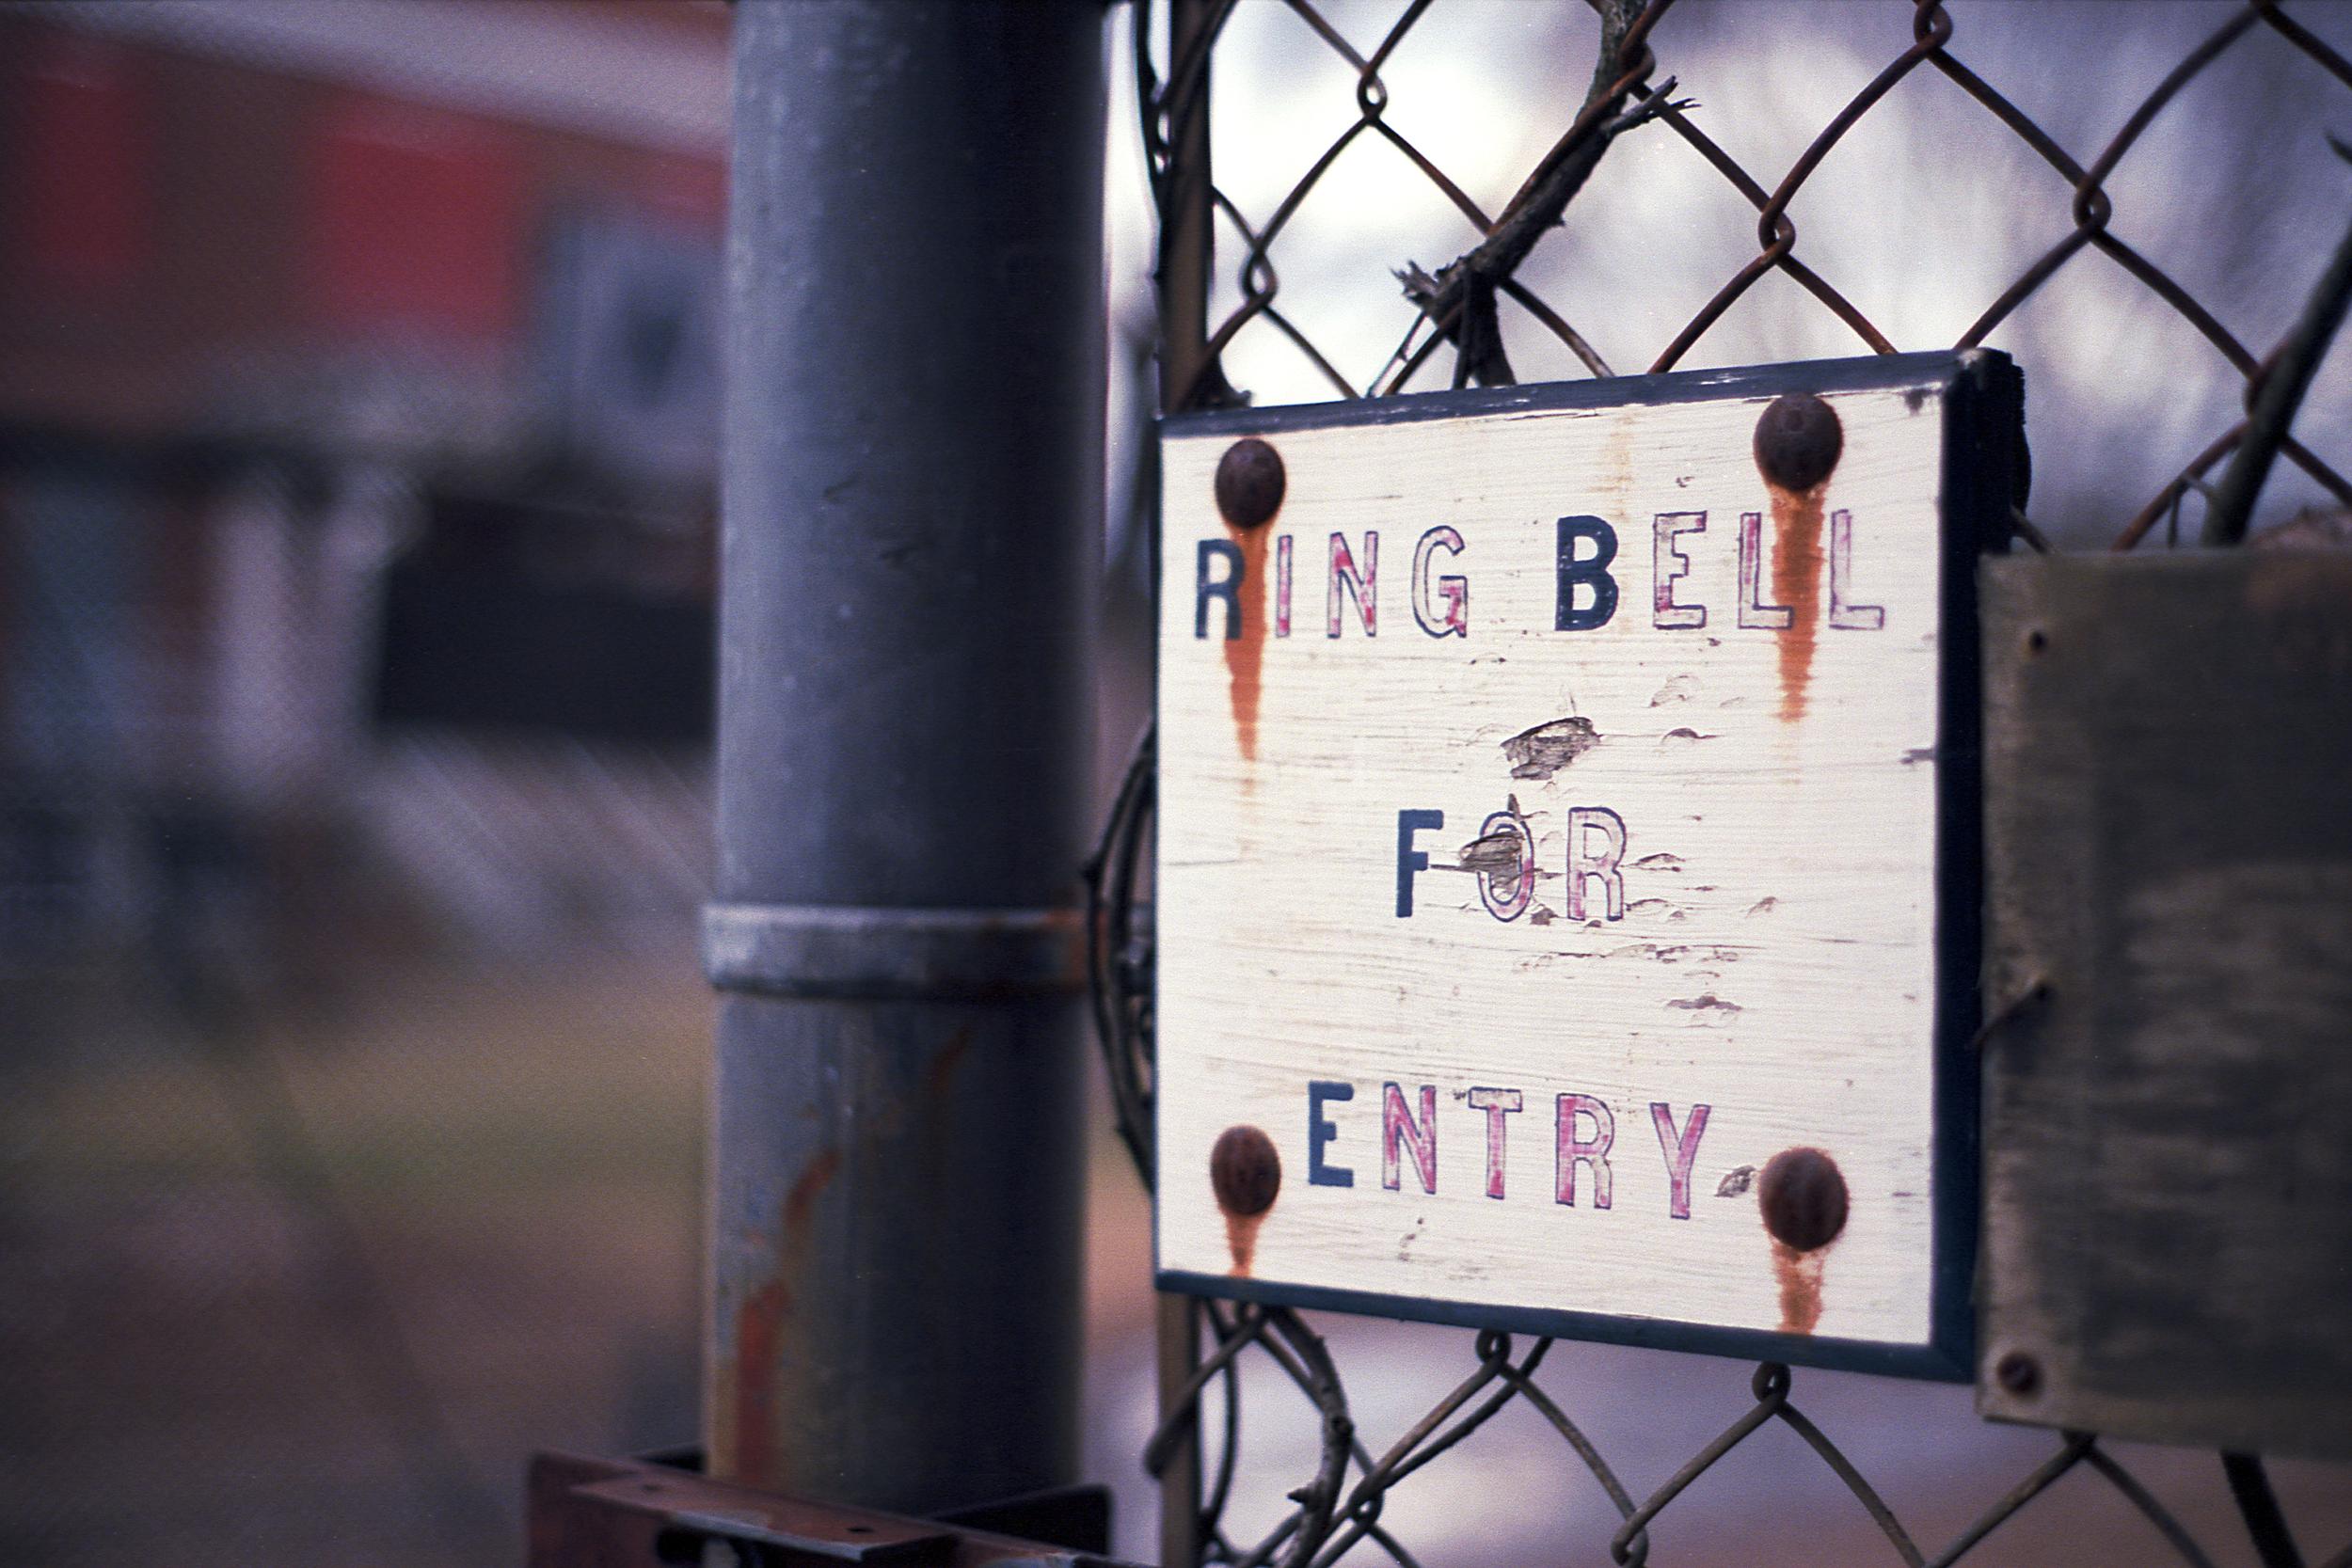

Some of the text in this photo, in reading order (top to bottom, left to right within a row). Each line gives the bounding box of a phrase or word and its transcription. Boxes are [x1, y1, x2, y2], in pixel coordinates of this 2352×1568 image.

[1195, 509, 1884, 639] RING BELL
[1395, 806, 1628, 922] FOR
[1308, 1080, 1711, 1220] ENTRY
